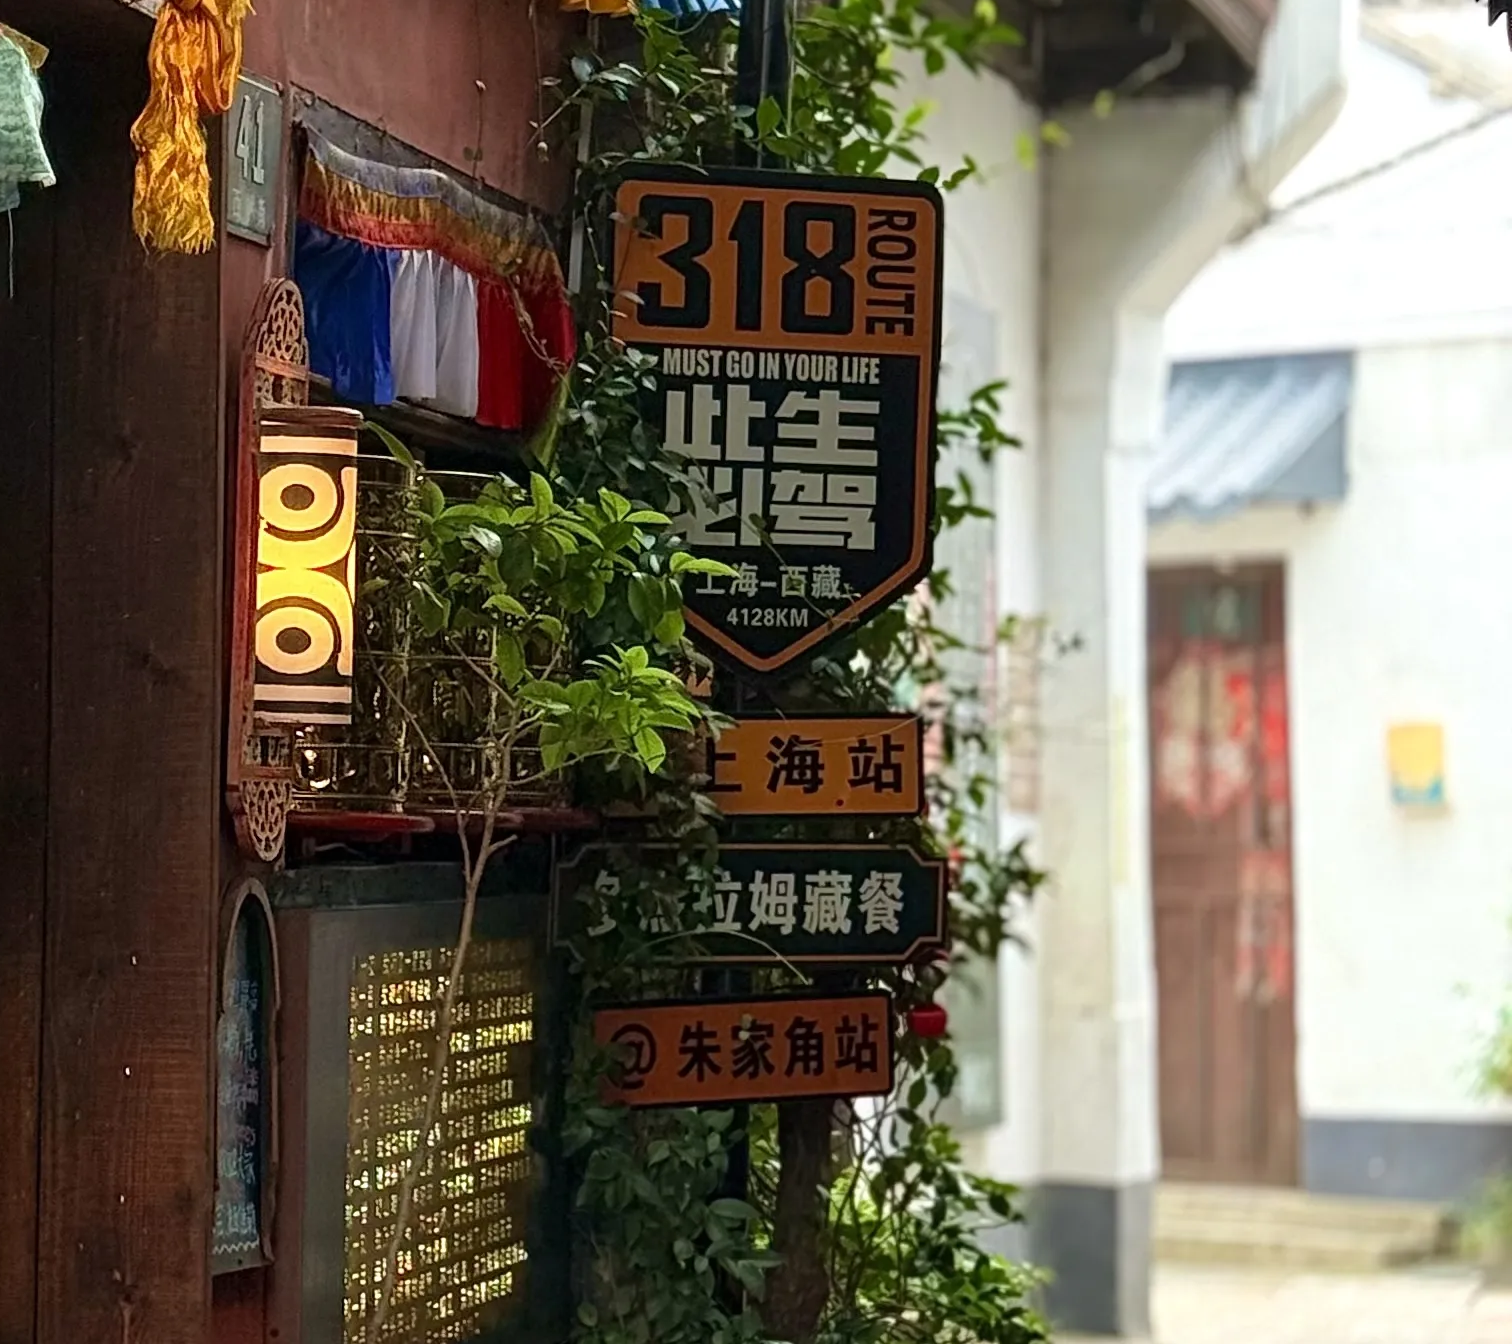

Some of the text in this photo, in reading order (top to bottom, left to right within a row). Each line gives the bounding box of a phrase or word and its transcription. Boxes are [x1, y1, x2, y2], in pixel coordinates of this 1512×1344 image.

[235, 95, 265, 185] 41
[635, 194, 856, 335] 318
[865, 208, 917, 338] ROUTE
[662, 348, 880, 384] MUST GO IN YOUR LIFE
[662, 383, 880, 467] 此生
[726, 607, 809, 628] 4128KM
[706, 734, 905, 794] 上海站
